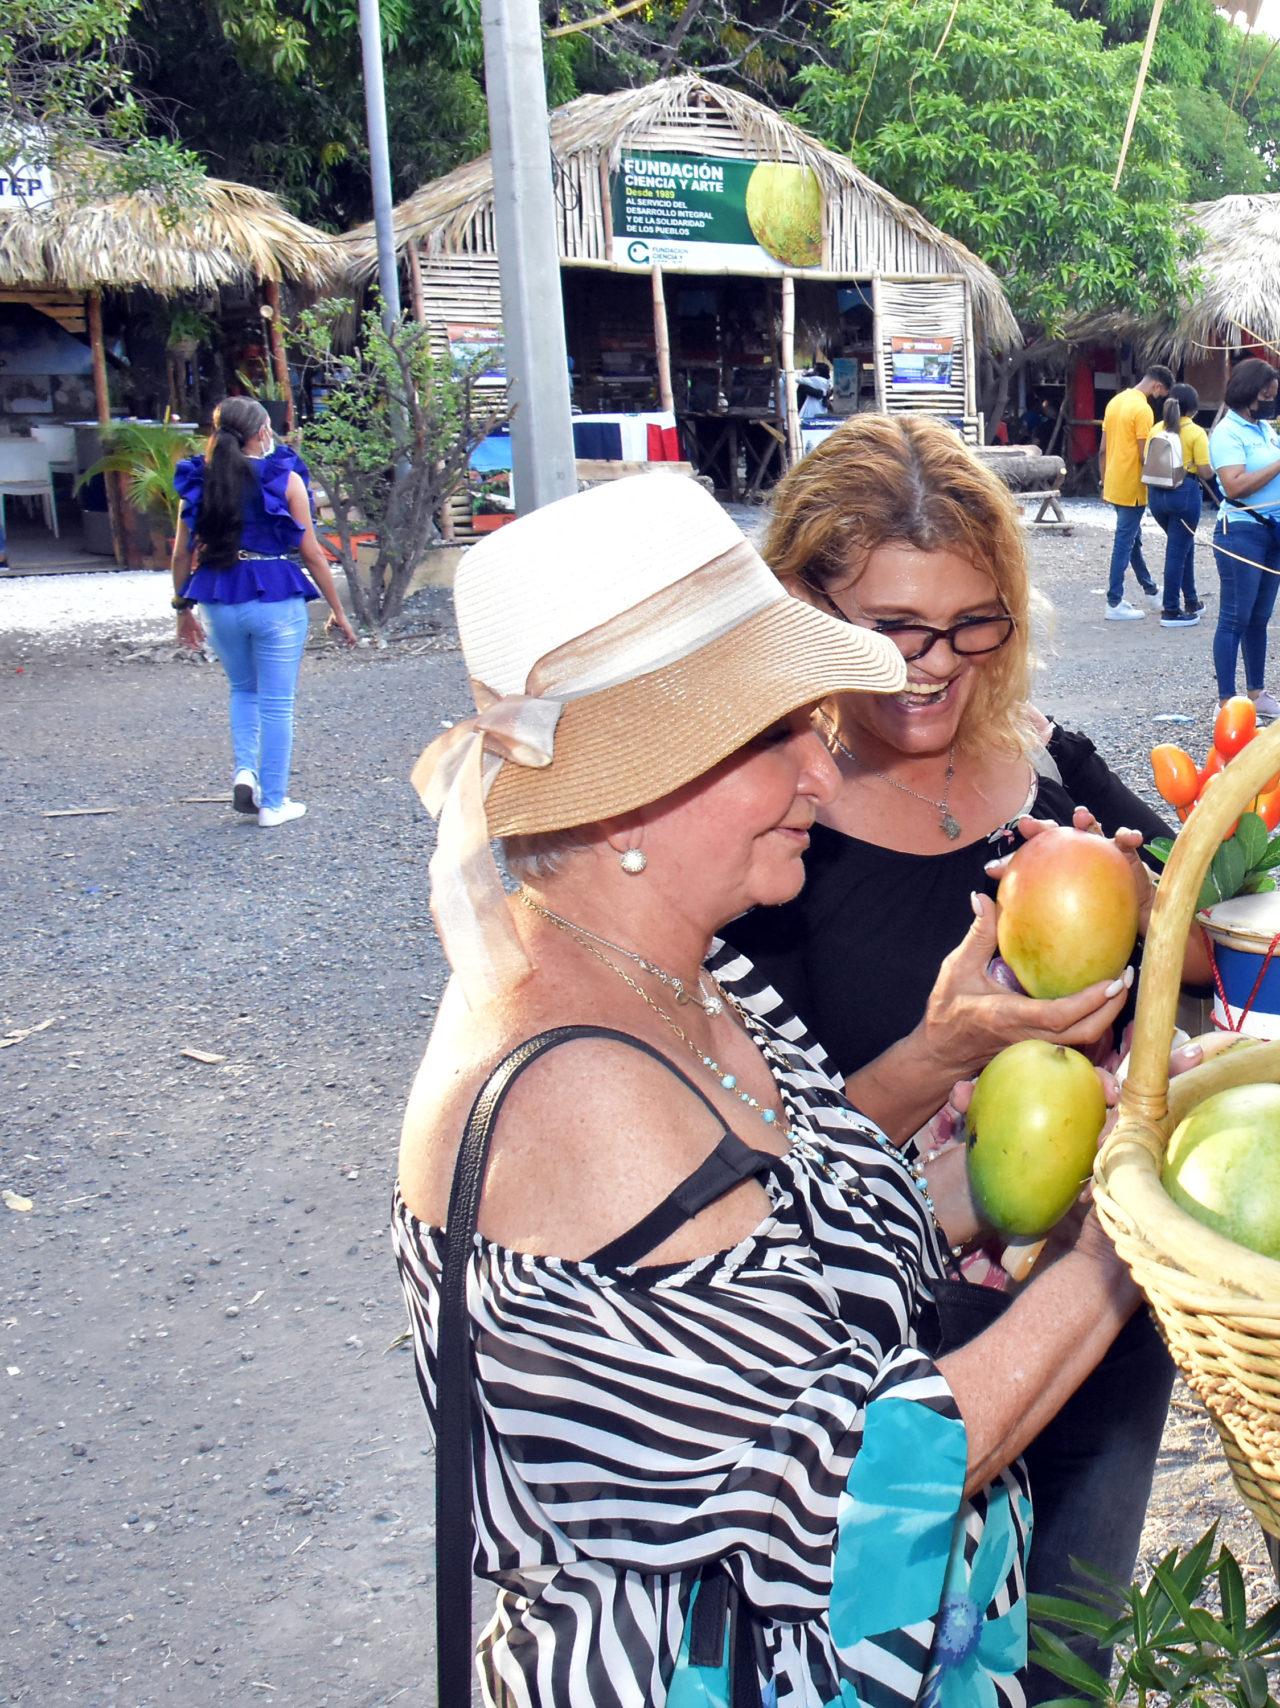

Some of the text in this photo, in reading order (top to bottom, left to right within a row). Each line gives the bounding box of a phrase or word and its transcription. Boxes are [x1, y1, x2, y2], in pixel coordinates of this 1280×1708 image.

[624, 159, 724, 180] FUNDACIÓN
[624, 174, 724, 193] CIENCIA Y ARTE
[625, 187, 675, 199] Desde 1989
[637, 199, 672, 208] SERVICIO
[673, 201, 687, 209] DEL
[626, 206, 714, 220] DESARROLLO INTEGRAL
[633, 216, 644, 224] DE
[645, 217, 656, 225] LA
[656, 219, 706, 228] SOLIDARIDAD
[655, 227, 690, 236] PUEBLOS
